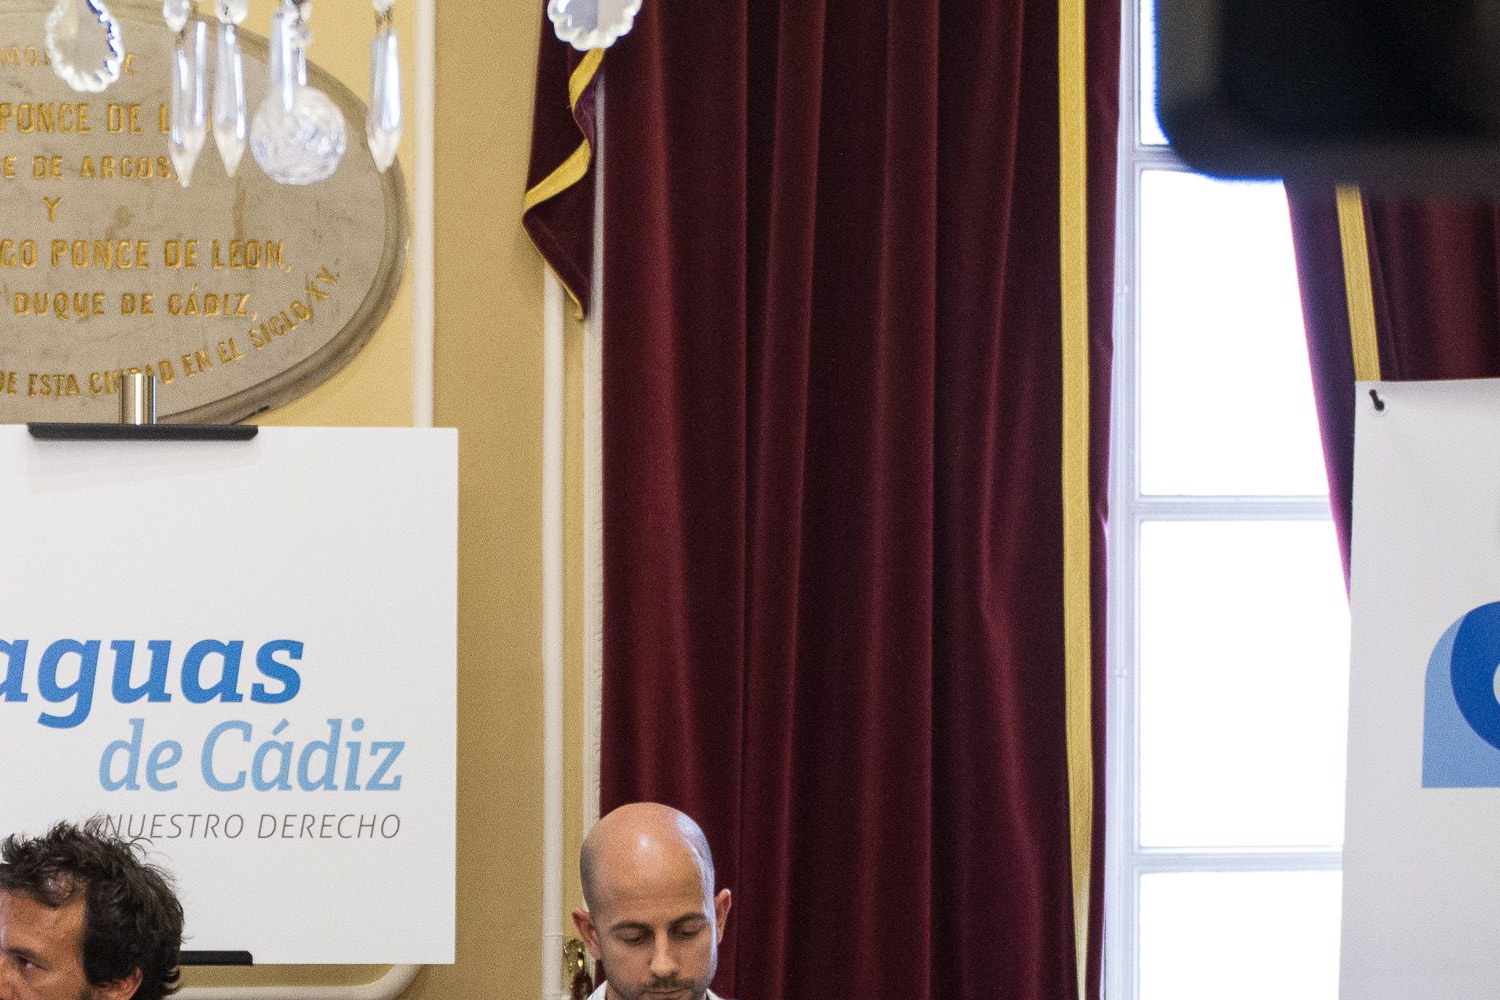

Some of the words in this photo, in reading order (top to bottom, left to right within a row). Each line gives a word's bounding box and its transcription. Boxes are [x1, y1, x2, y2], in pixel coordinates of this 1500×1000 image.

[106, 102, 143, 134] DE
[32, 154, 64, 180] DE
[41, 195, 62, 225] Y
[50, 239, 150, 270] PONCE
[164, 239, 200, 270] DE
[13, 291, 106, 321] DUQUE
[121, 292, 156, 317] DE
[28, 373, 80, 397] ESTA
[89, 361, 176, 395] CIUD
[182, 350, 213, 377] EN
[219, 337, 244, 365] EL
[248, 300, 310, 350] SIGLO
[99, 717, 183, 792] de
[200, 717, 406, 792] Cádiz
[256, 813, 401, 839] DERECHO
